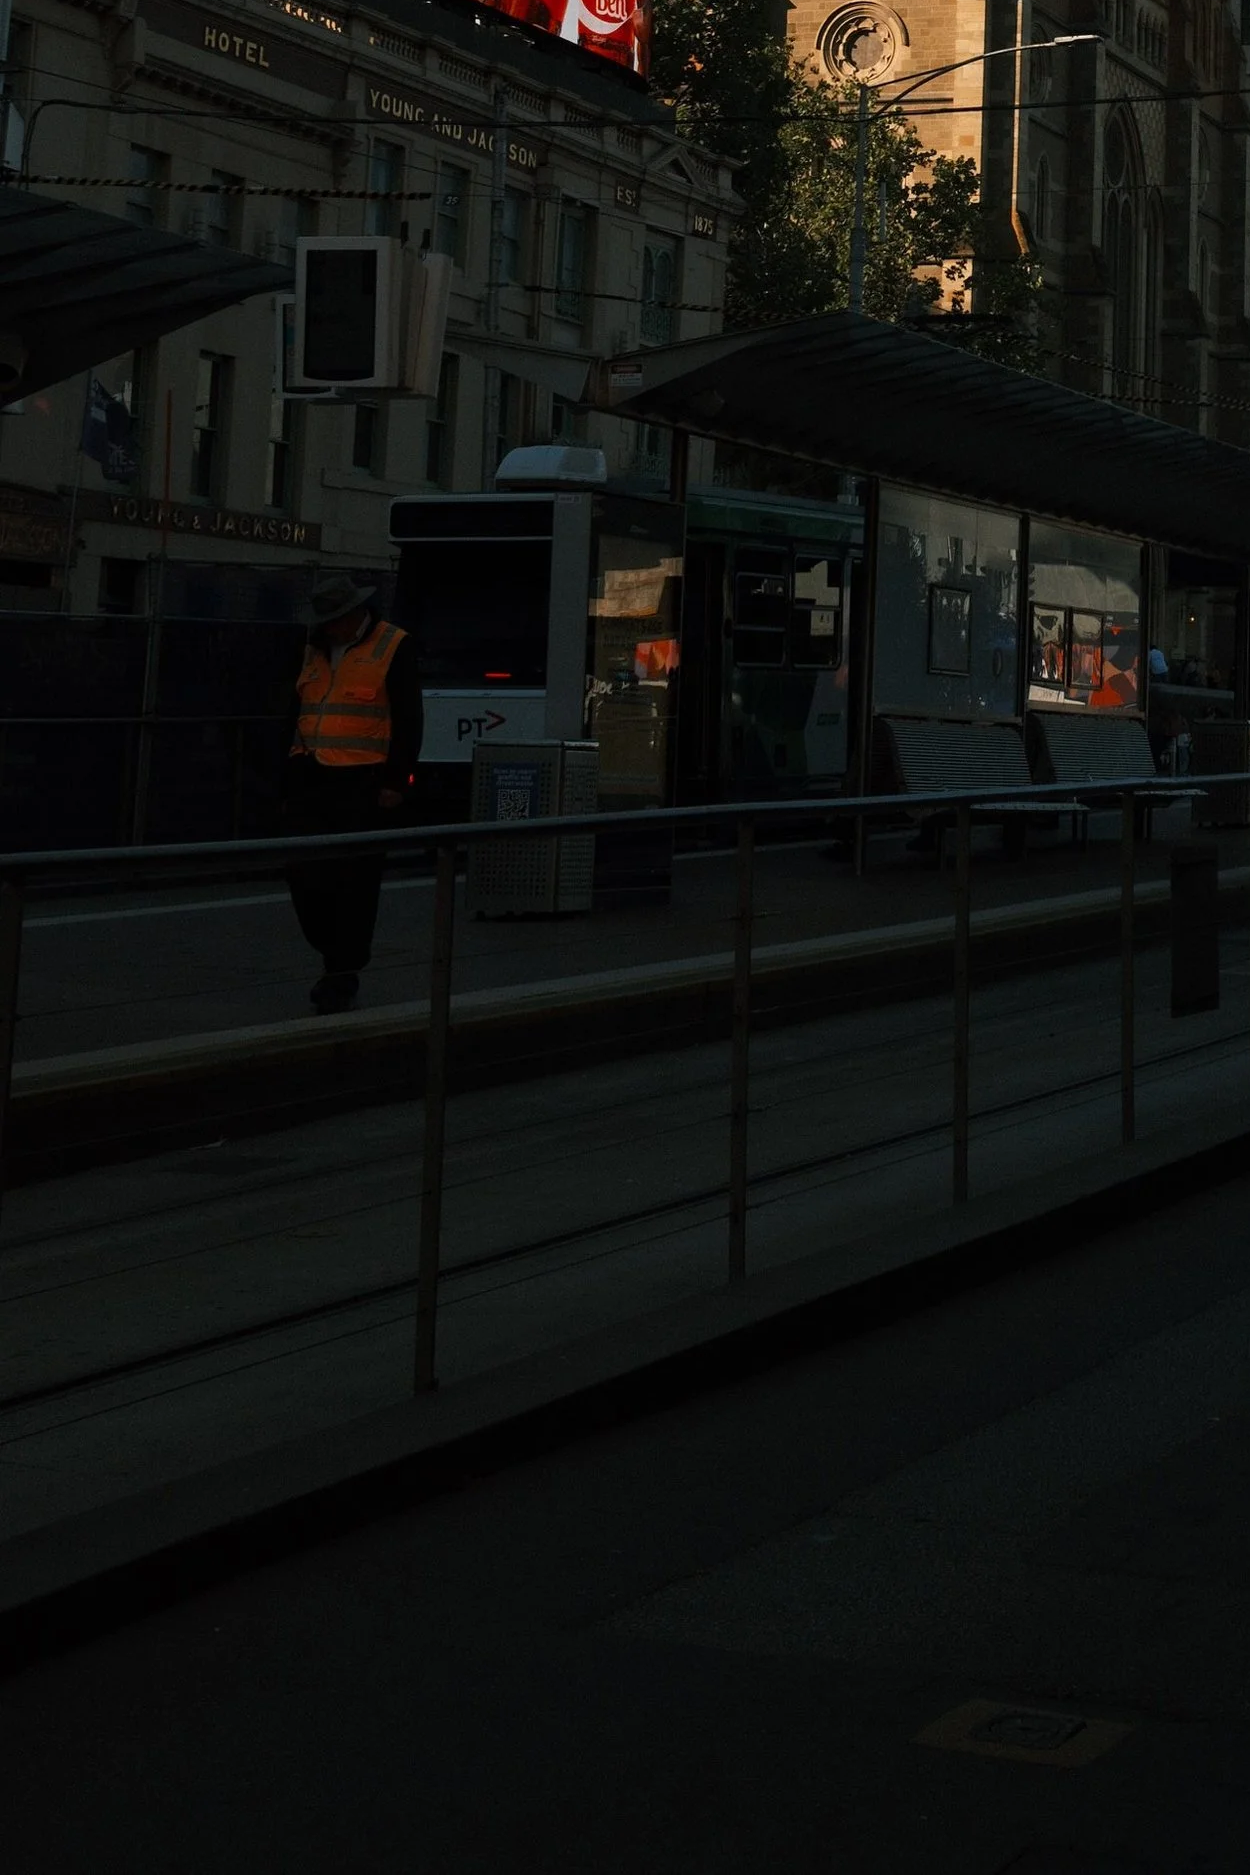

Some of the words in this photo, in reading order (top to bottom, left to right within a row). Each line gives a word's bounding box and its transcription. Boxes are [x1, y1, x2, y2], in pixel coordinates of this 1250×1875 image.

[204, 25, 270, 69] HOTEL
[431, 113, 463, 141] AND
[467, 128, 538, 169] JACSON
[694, 214, 714, 236] 1875
[209, 510, 306, 544] JACKSON
